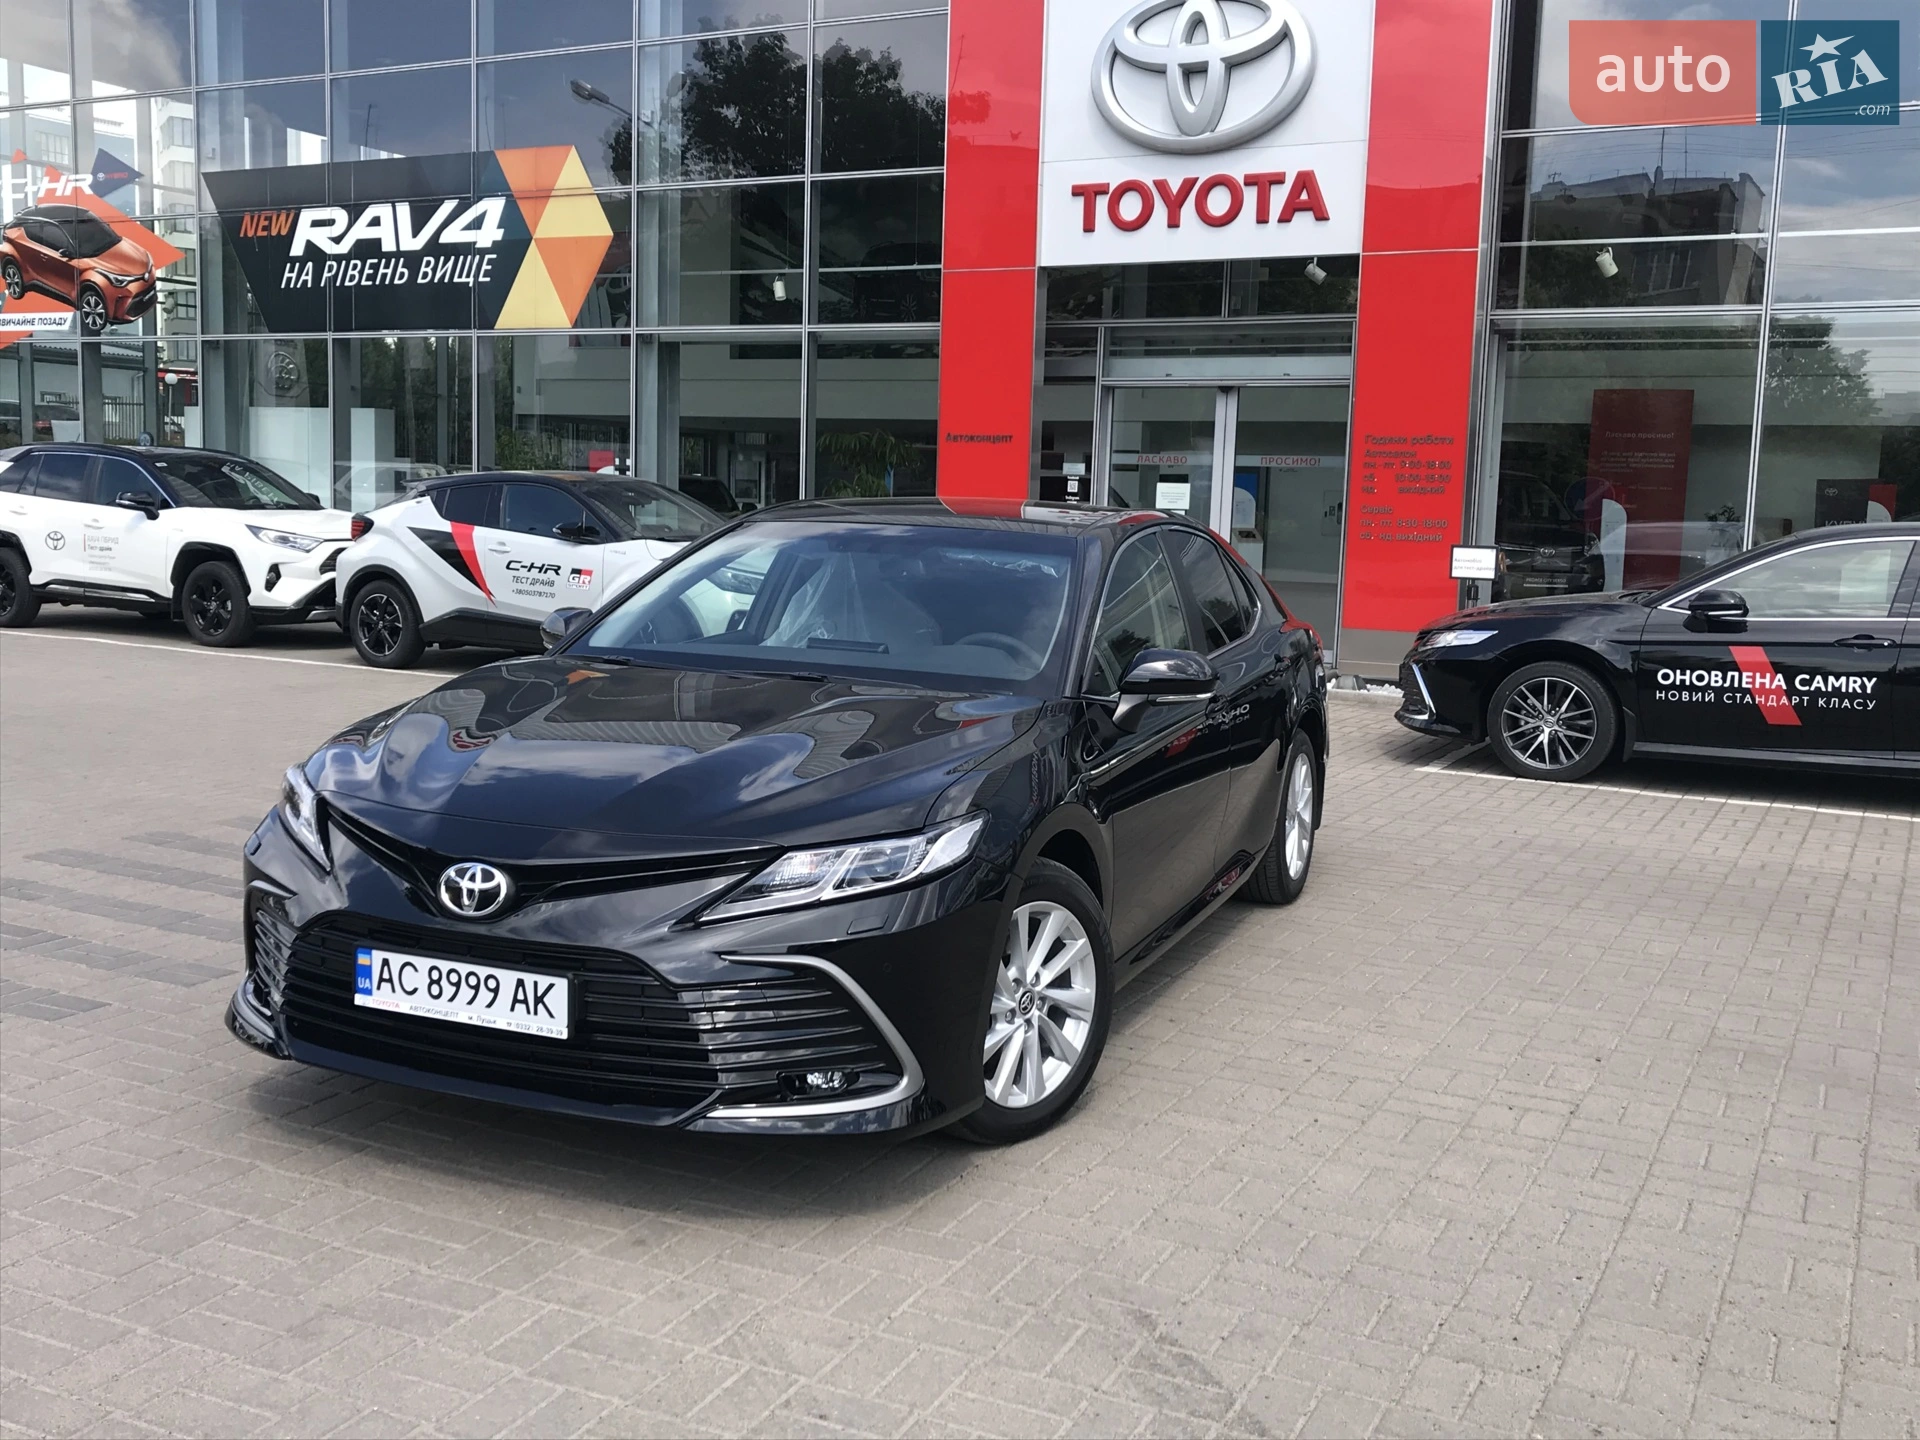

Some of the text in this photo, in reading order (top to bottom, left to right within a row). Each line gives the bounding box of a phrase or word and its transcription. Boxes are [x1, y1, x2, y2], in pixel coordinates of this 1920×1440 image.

[1071, 169, 1330, 232] TOYOTA
[239, 196, 507, 256] NEW RAV4
[281, 254, 497, 289] НА РІВЕНЬ ВИЩЕ
[37, 316, 68, 326] ПОЗАДУ
[945, 432, 1013, 444] Автоконцепт
[1137, 455, 1188, 464] ЛАСКАВО
[1260, 456, 1321, 467] ПРОСИМО!
[505, 559, 562, 576] C-HR
[511, 575, 555, 587] ТЕСТ ДРАЙВ
[568, 573, 592, 585] GR
[1656, 668, 1878, 694] ОНОВЛЕНА CAMRY
[1656, 689, 1877, 710] НОВИЙ СТАНДАРТ КЛАСУ
[357, 977, 371, 990] UA
[376, 957, 556, 1019] AC 8999 AK
[371, 998, 400, 1009] TOYOTA
